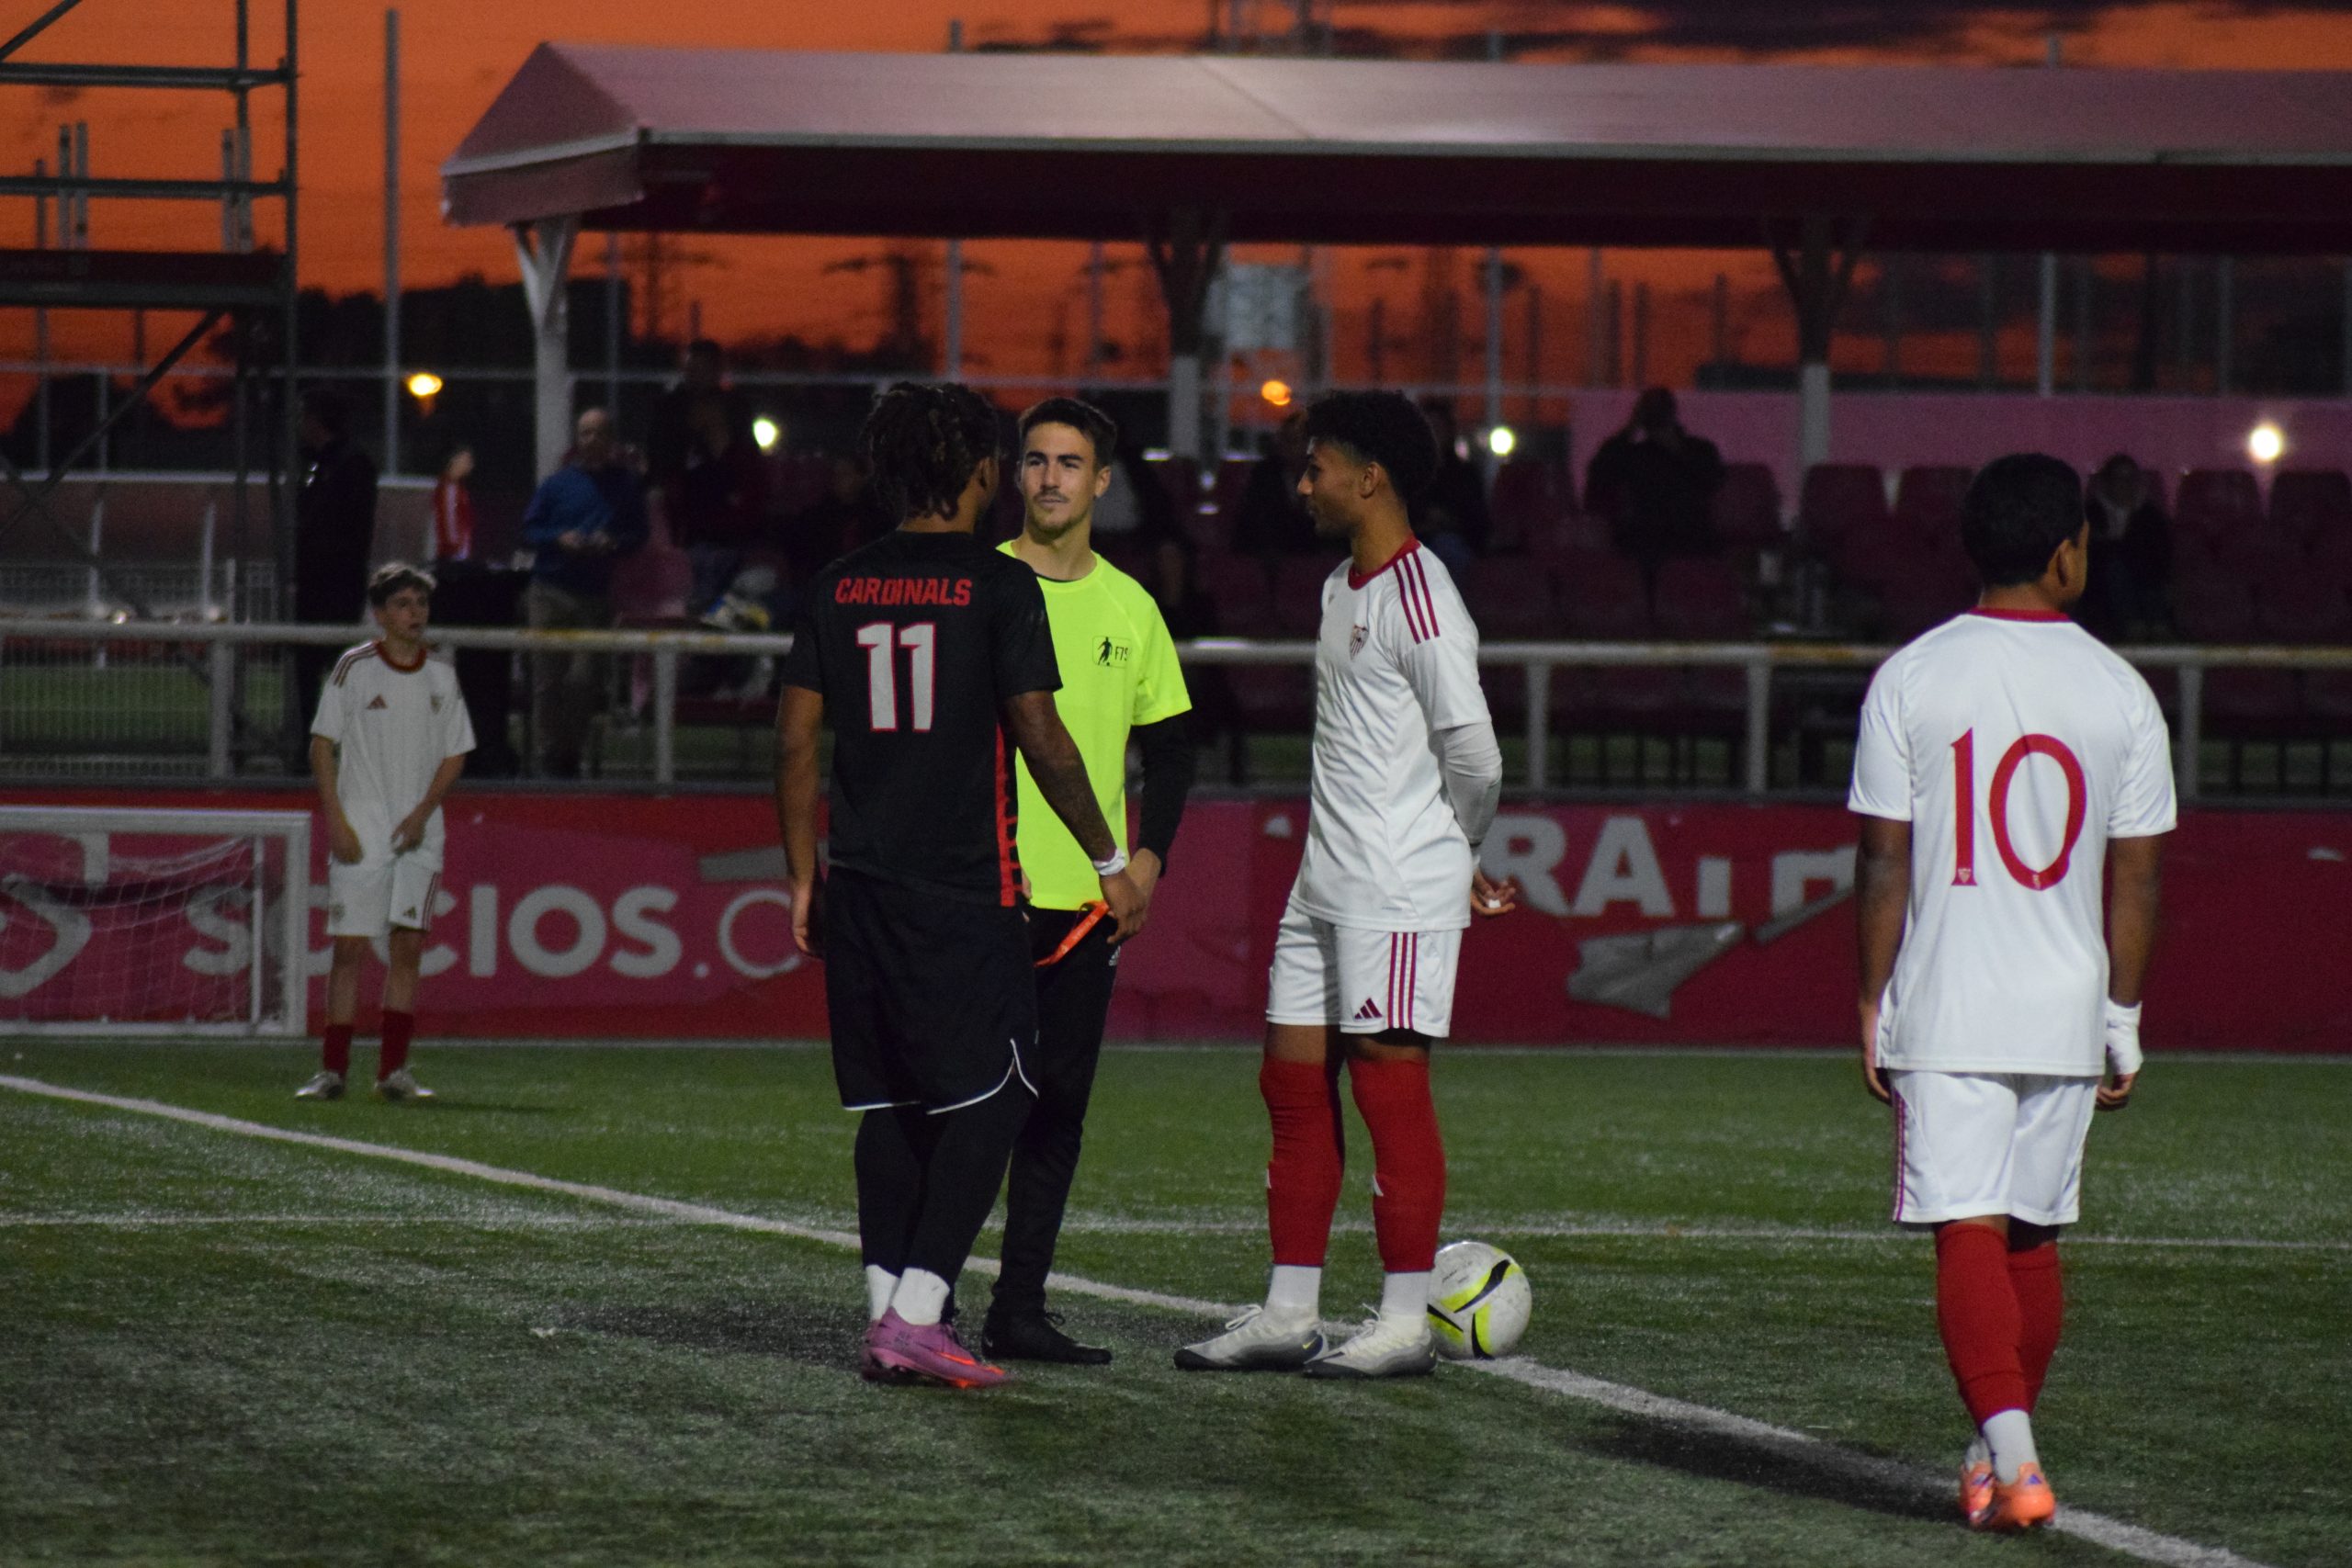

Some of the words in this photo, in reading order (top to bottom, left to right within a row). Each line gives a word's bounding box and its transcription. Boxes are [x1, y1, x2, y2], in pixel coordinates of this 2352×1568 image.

[834, 577, 972, 606] CARDINALS
[855, 621, 936, 733] 11
[1951, 727, 2087, 891] 10
